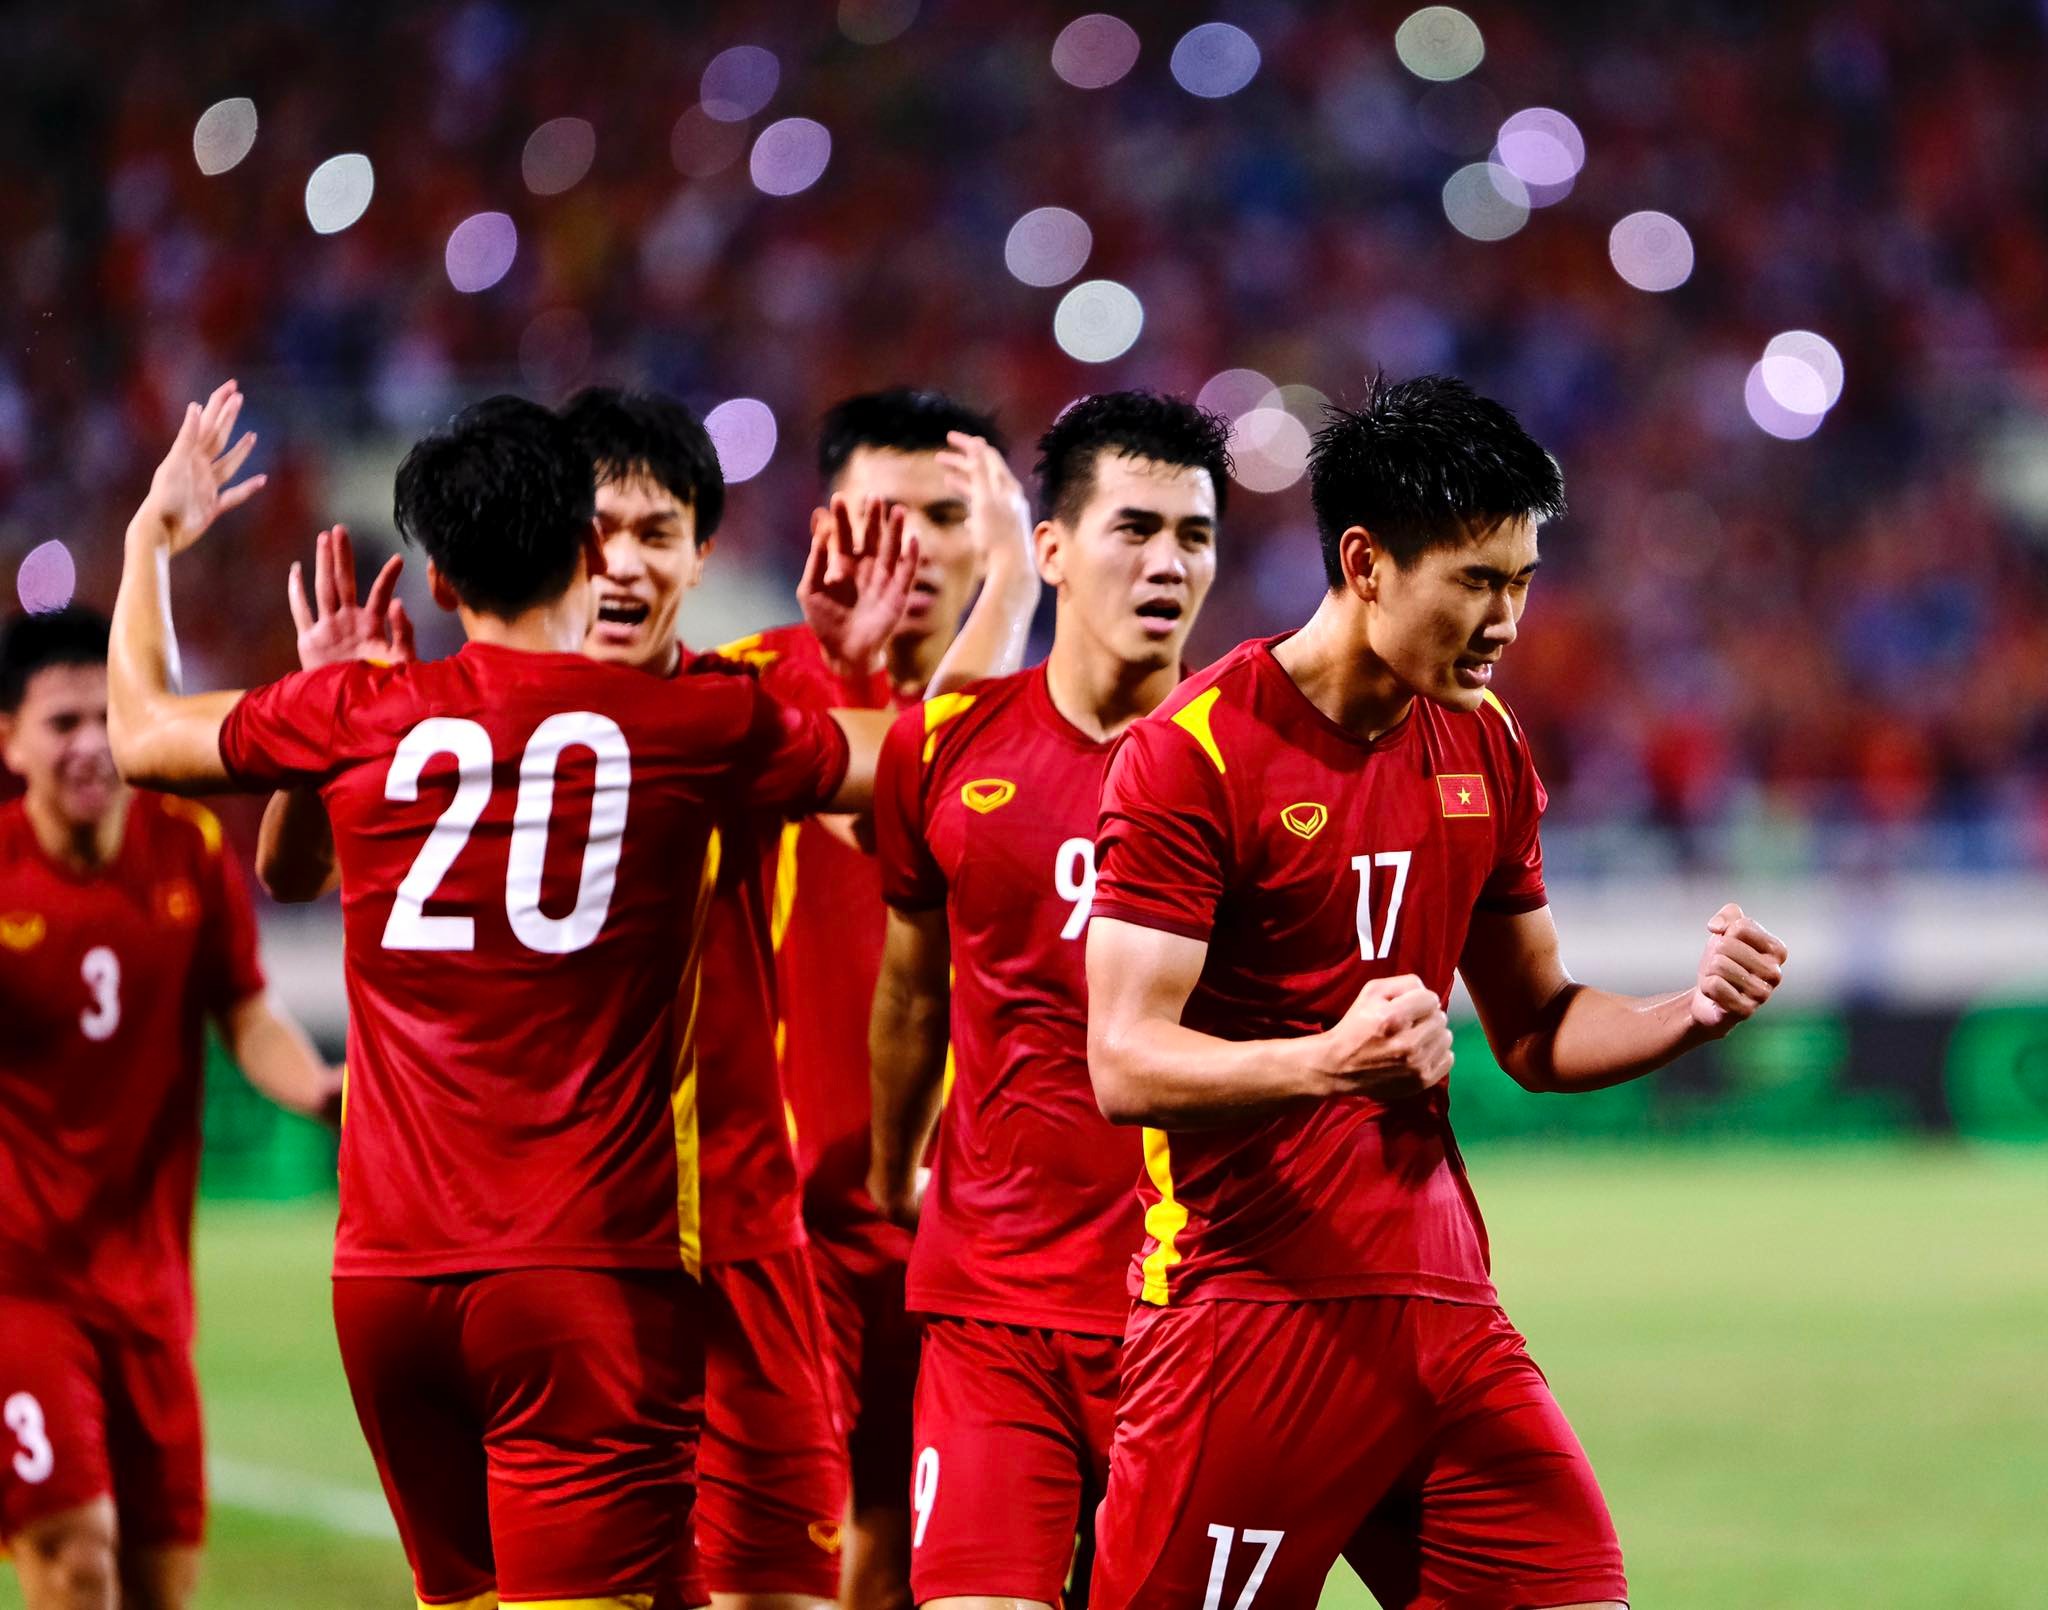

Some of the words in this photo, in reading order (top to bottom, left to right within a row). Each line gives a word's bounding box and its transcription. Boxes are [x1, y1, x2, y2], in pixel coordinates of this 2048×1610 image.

[381, 711, 632, 954] 20
[1054, 837, 1098, 940] 9
[1351, 850, 1413, 961] 17
[80, 947, 120, 1040] 3
[2, 1391, 54, 1484] 3
[913, 1446, 940, 1549] 9
[1202, 1523, 1285, 1610] 17
